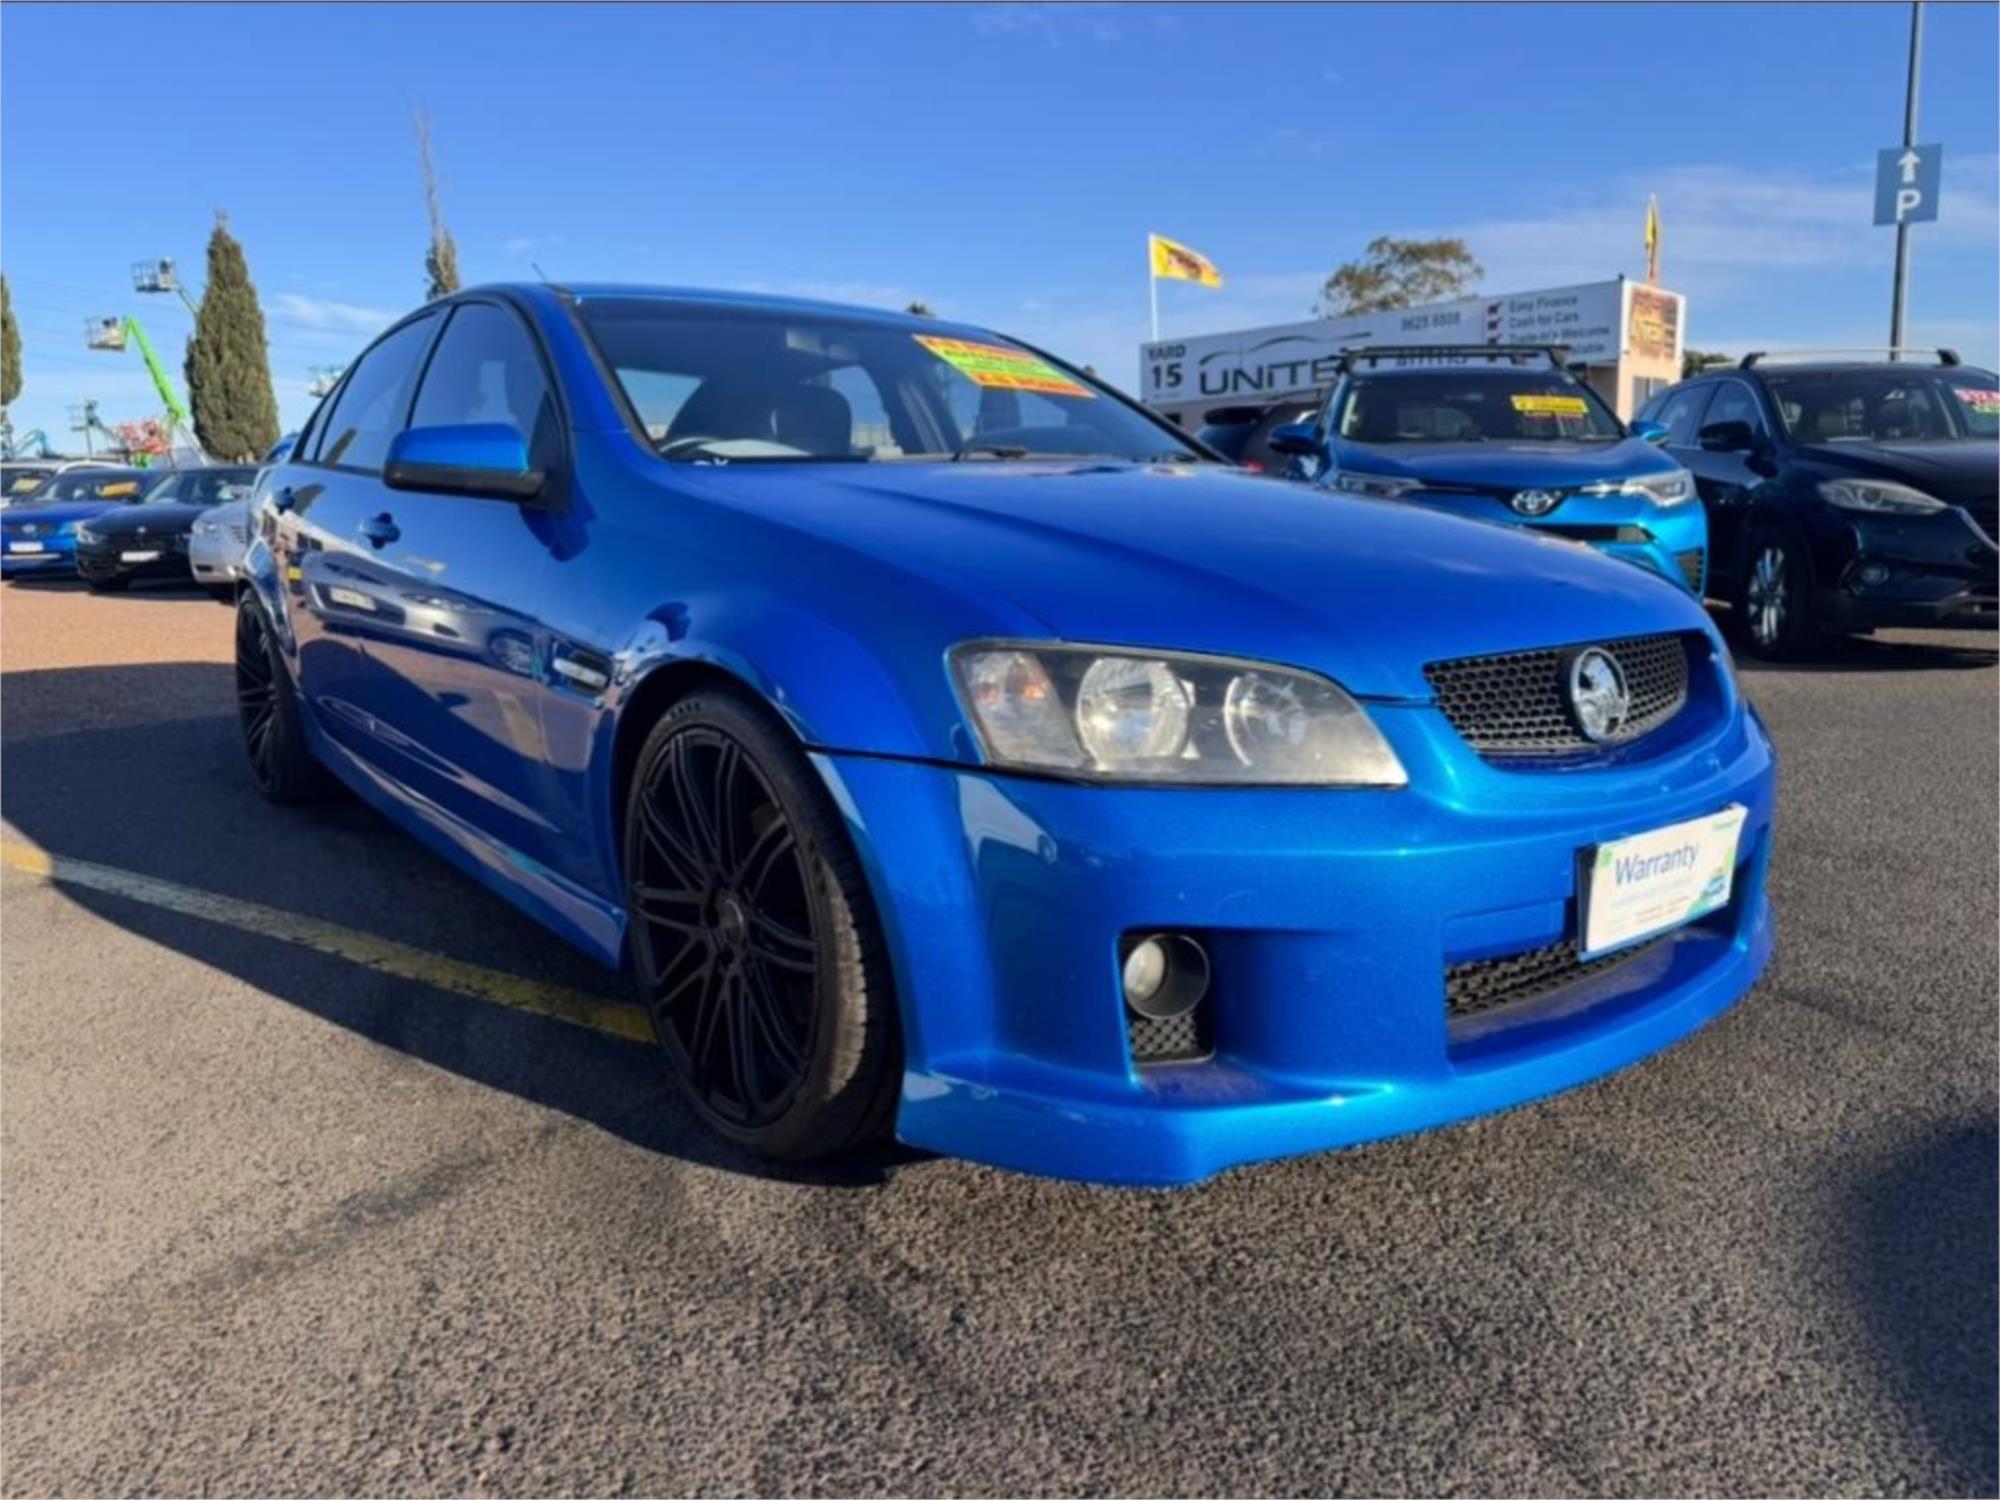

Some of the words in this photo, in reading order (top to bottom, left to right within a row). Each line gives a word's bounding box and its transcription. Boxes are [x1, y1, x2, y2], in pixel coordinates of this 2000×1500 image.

[1896, 190, 1922, 221] P
[1537, 296, 1578, 309] Finance
[1509, 316, 1535, 329] Cash
[1537, 314, 1552, 325] for
[1555, 312, 1579, 325] Cars
[1561, 325, 1610, 339] Welcome
[1147, 344, 1187, 361] YARD
[1152, 363, 1183, 390] 15
[1199, 353, 1342, 396] UNITE
[1615, 842, 1701, 887] Warranty
